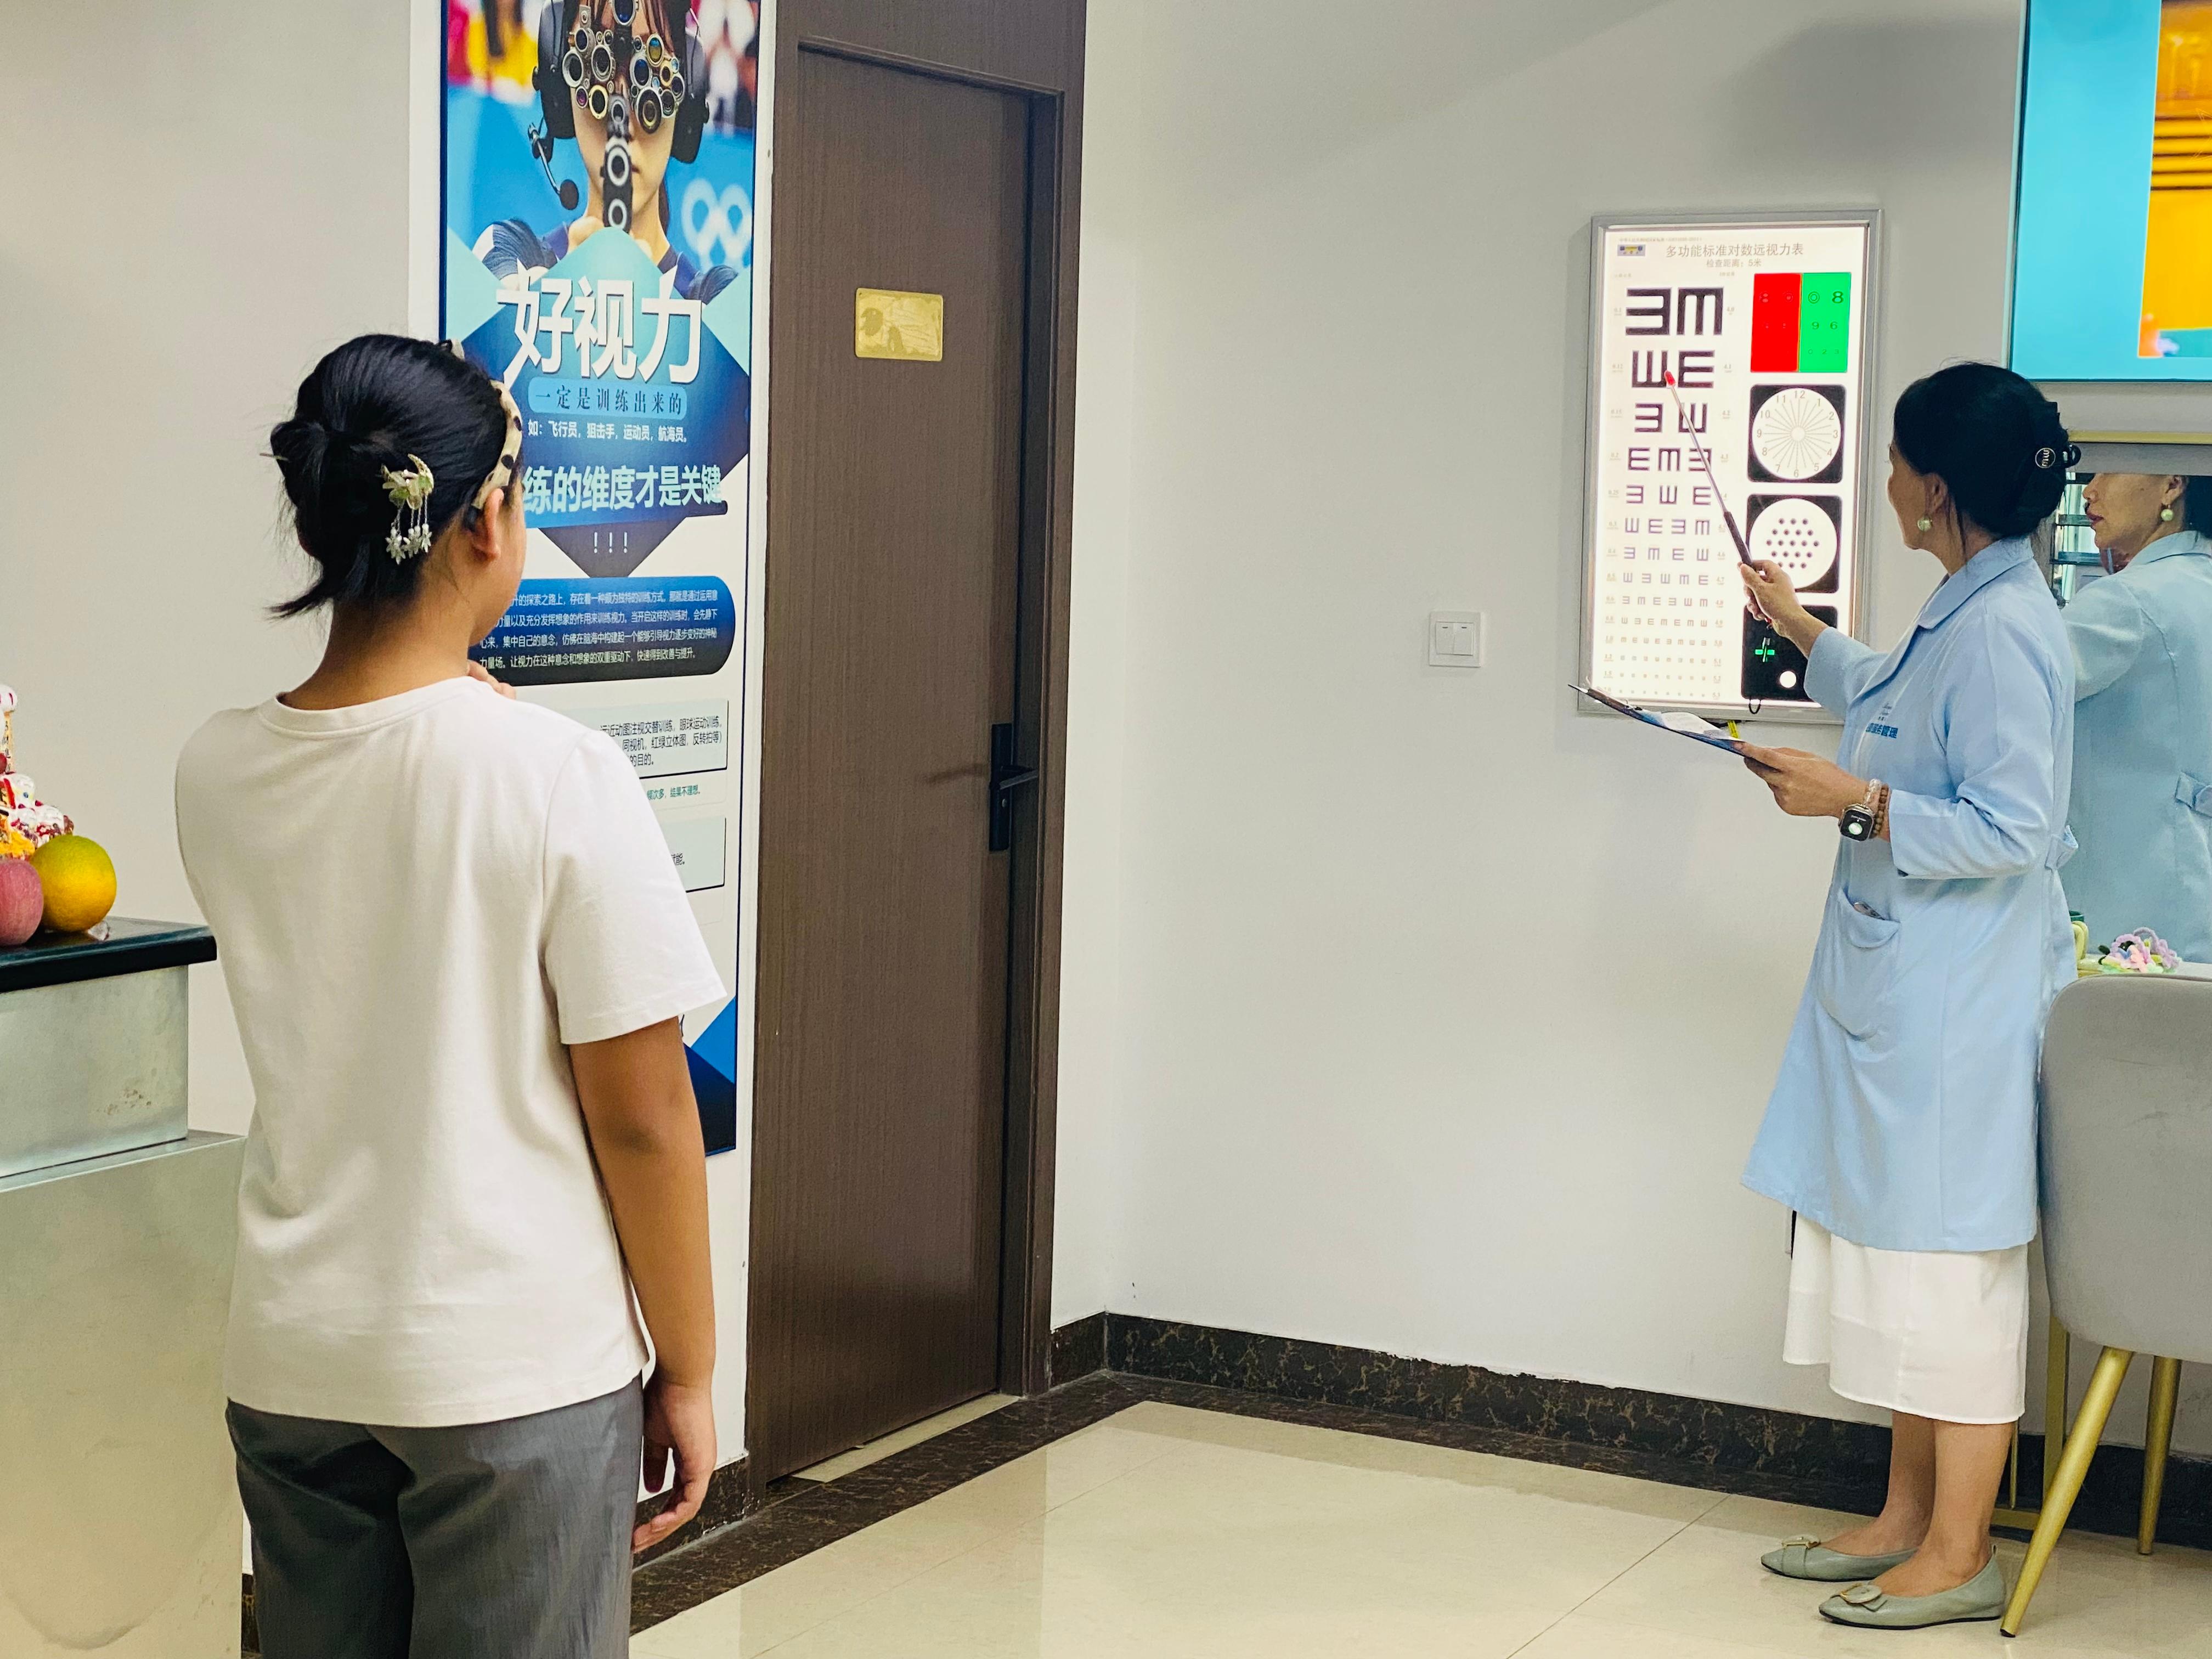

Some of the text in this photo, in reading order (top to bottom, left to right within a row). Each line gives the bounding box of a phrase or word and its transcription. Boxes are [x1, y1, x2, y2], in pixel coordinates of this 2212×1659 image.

[1666, 242, 1804, 258] 多功能标准对数远视力表
[1832, 291, 1844, 304] 8
[496, 256, 702, 390] 好视力
[1776, 395, 1786, 403] 11
[1794, 390, 1805, 399] 12
[535, 384, 682, 415] 一定是训练出来的
[1817, 398, 1821, 407] 1
[1760, 410, 1770, 419] 10
[1829, 411, 1835, 420] 2
[1757, 429, 1762, 438] 9
[1833, 430, 1838, 438] 3
[1762, 447, 1768, 456] 8
[1827, 448, 1832, 457] 4
[1775, 464, 1781, 473] 7
[1813, 463, 1820, 472] 5
[1793, 469, 1799, 478] 6
